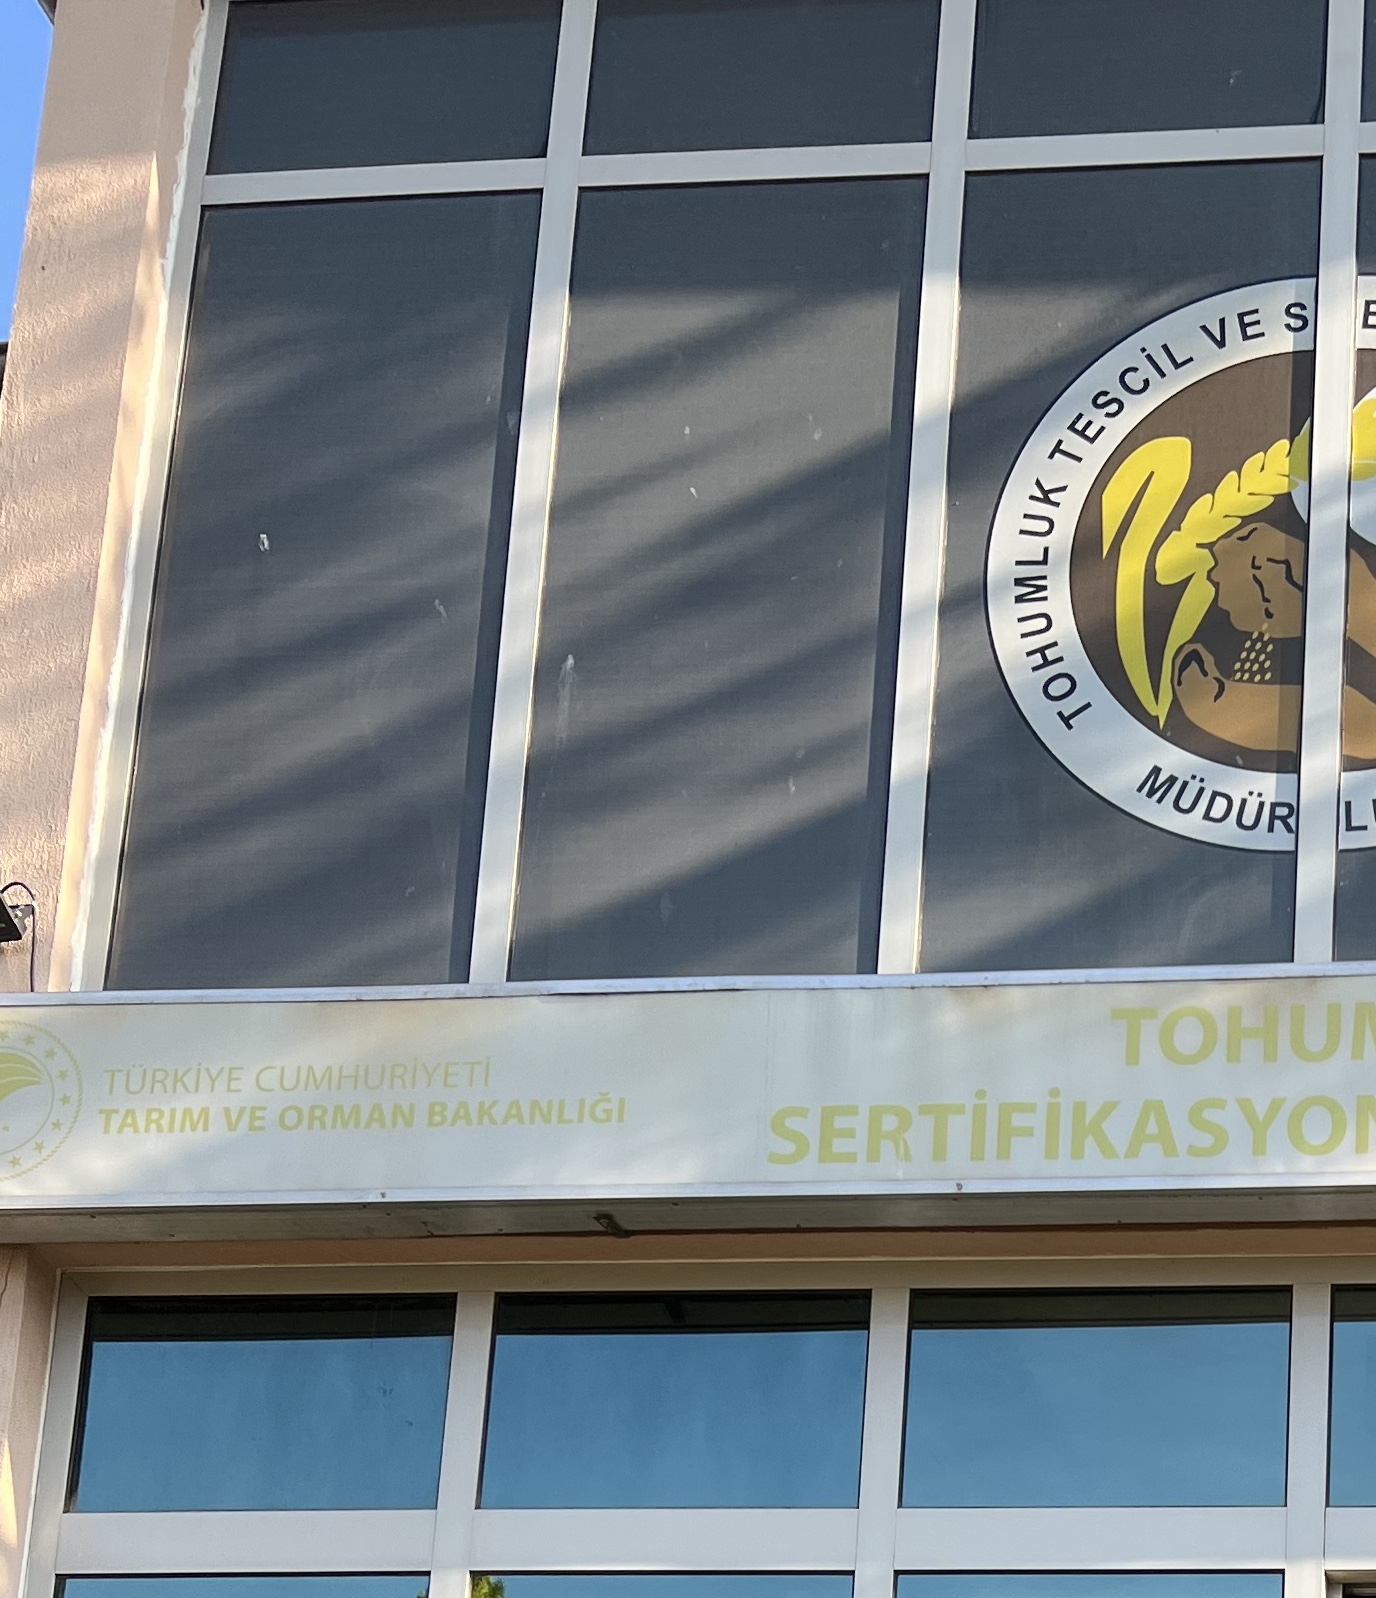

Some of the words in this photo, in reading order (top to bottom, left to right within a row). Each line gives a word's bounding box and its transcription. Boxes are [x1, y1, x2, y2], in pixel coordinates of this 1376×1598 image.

[1200, 308, 1266, 350] VE
[1047, 346, 1194, 465] TESCİL
[1013, 478, 1093, 731] TOHUMLUK
[105, 1062, 243, 1096] TÜRKİYE
[255, 1056, 492, 1094] CUMHURİYETİ
[99, 1107, 210, 1135] TARIM
[224, 1105, 267, 1133] VE
[278, 1101, 417, 1132] ORMAN
[427, 1091, 626, 1129] BAKANLIĞI
